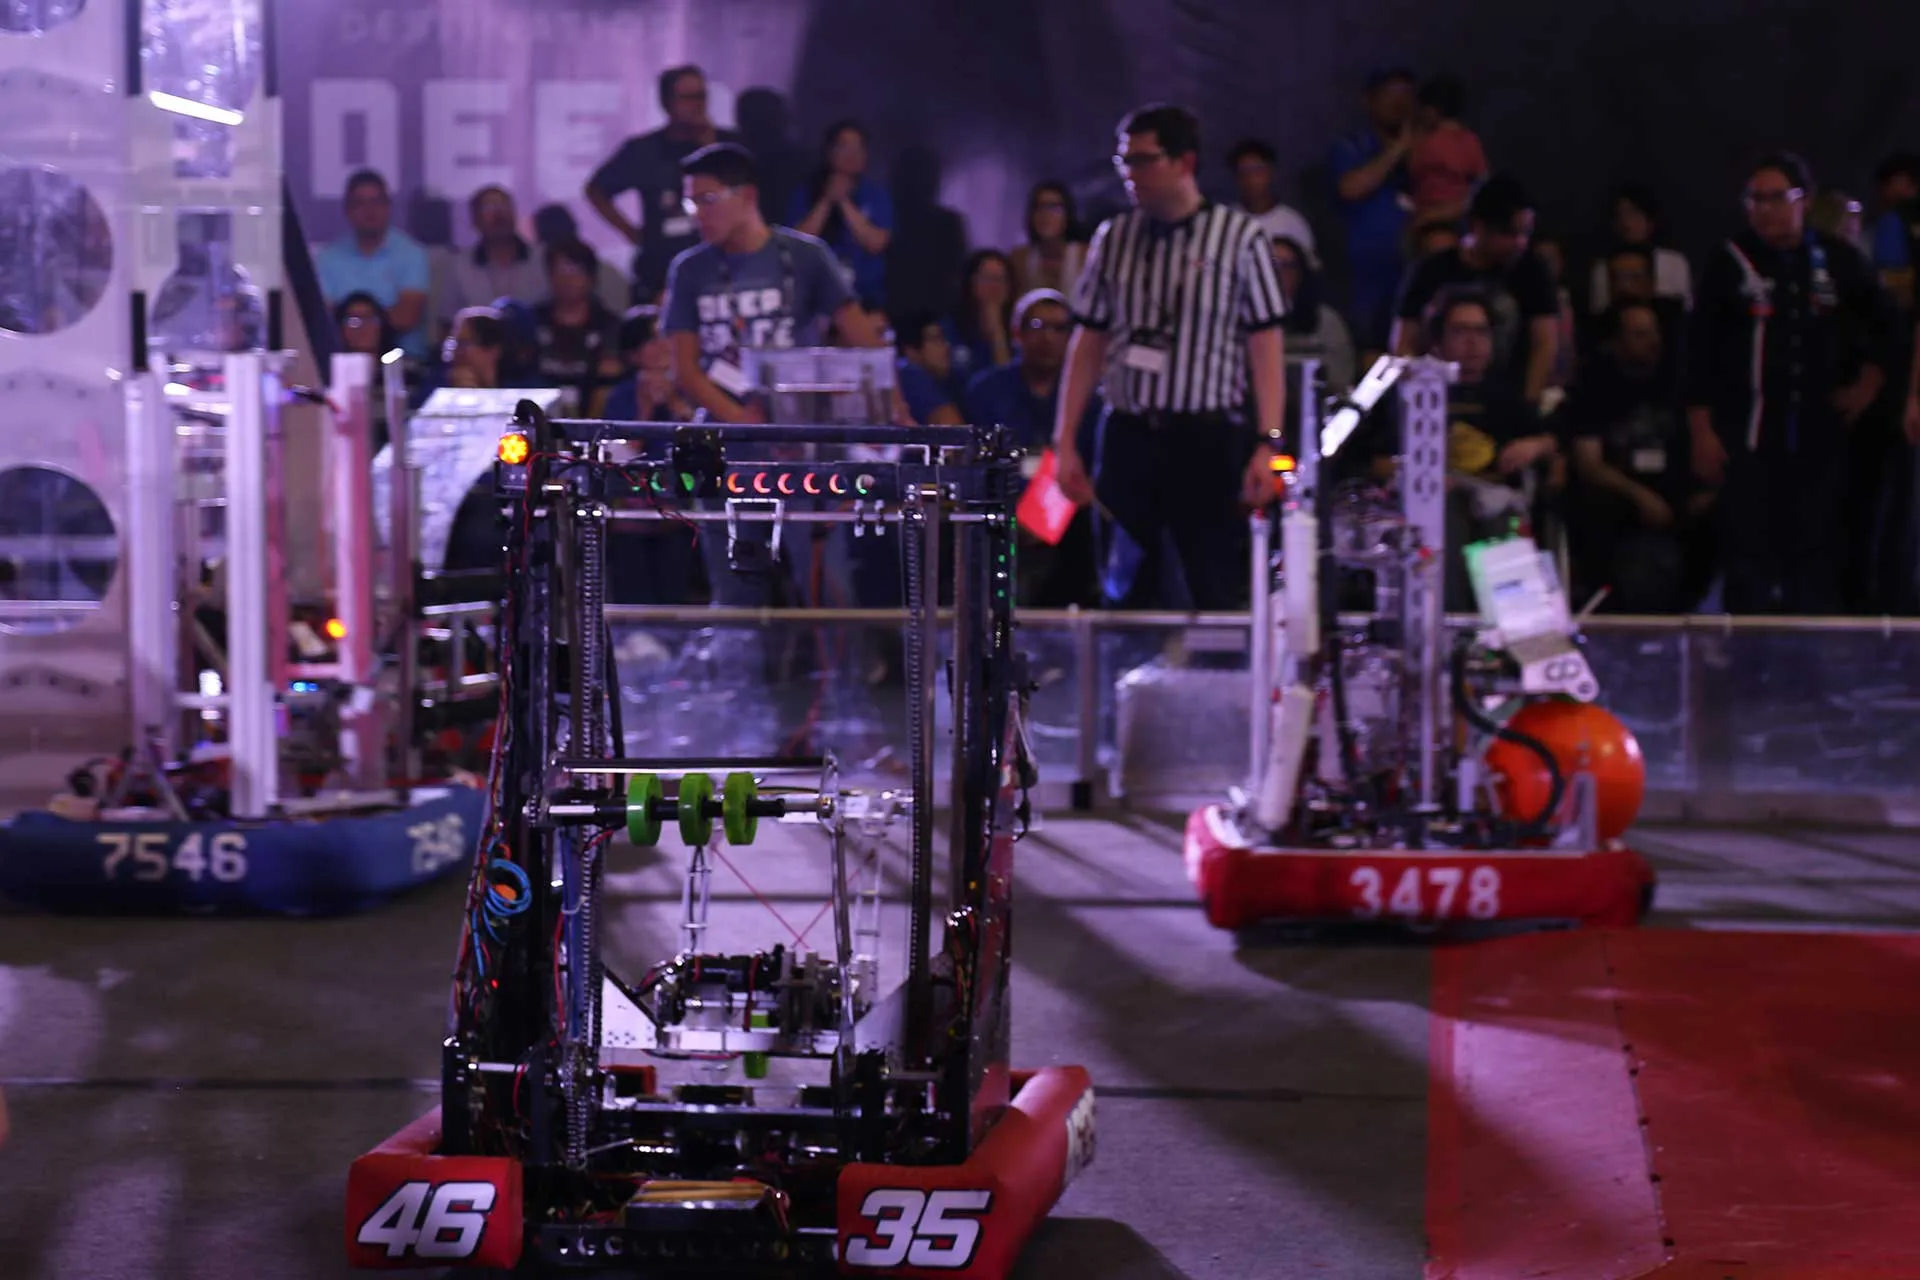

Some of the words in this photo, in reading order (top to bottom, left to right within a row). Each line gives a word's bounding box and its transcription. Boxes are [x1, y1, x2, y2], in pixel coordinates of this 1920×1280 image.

[96, 832, 248, 883] 7546
[1348, 864, 1502, 920] 3478
[356, 1179, 497, 1259] 46
[844, 1188, 993, 1268] 35
